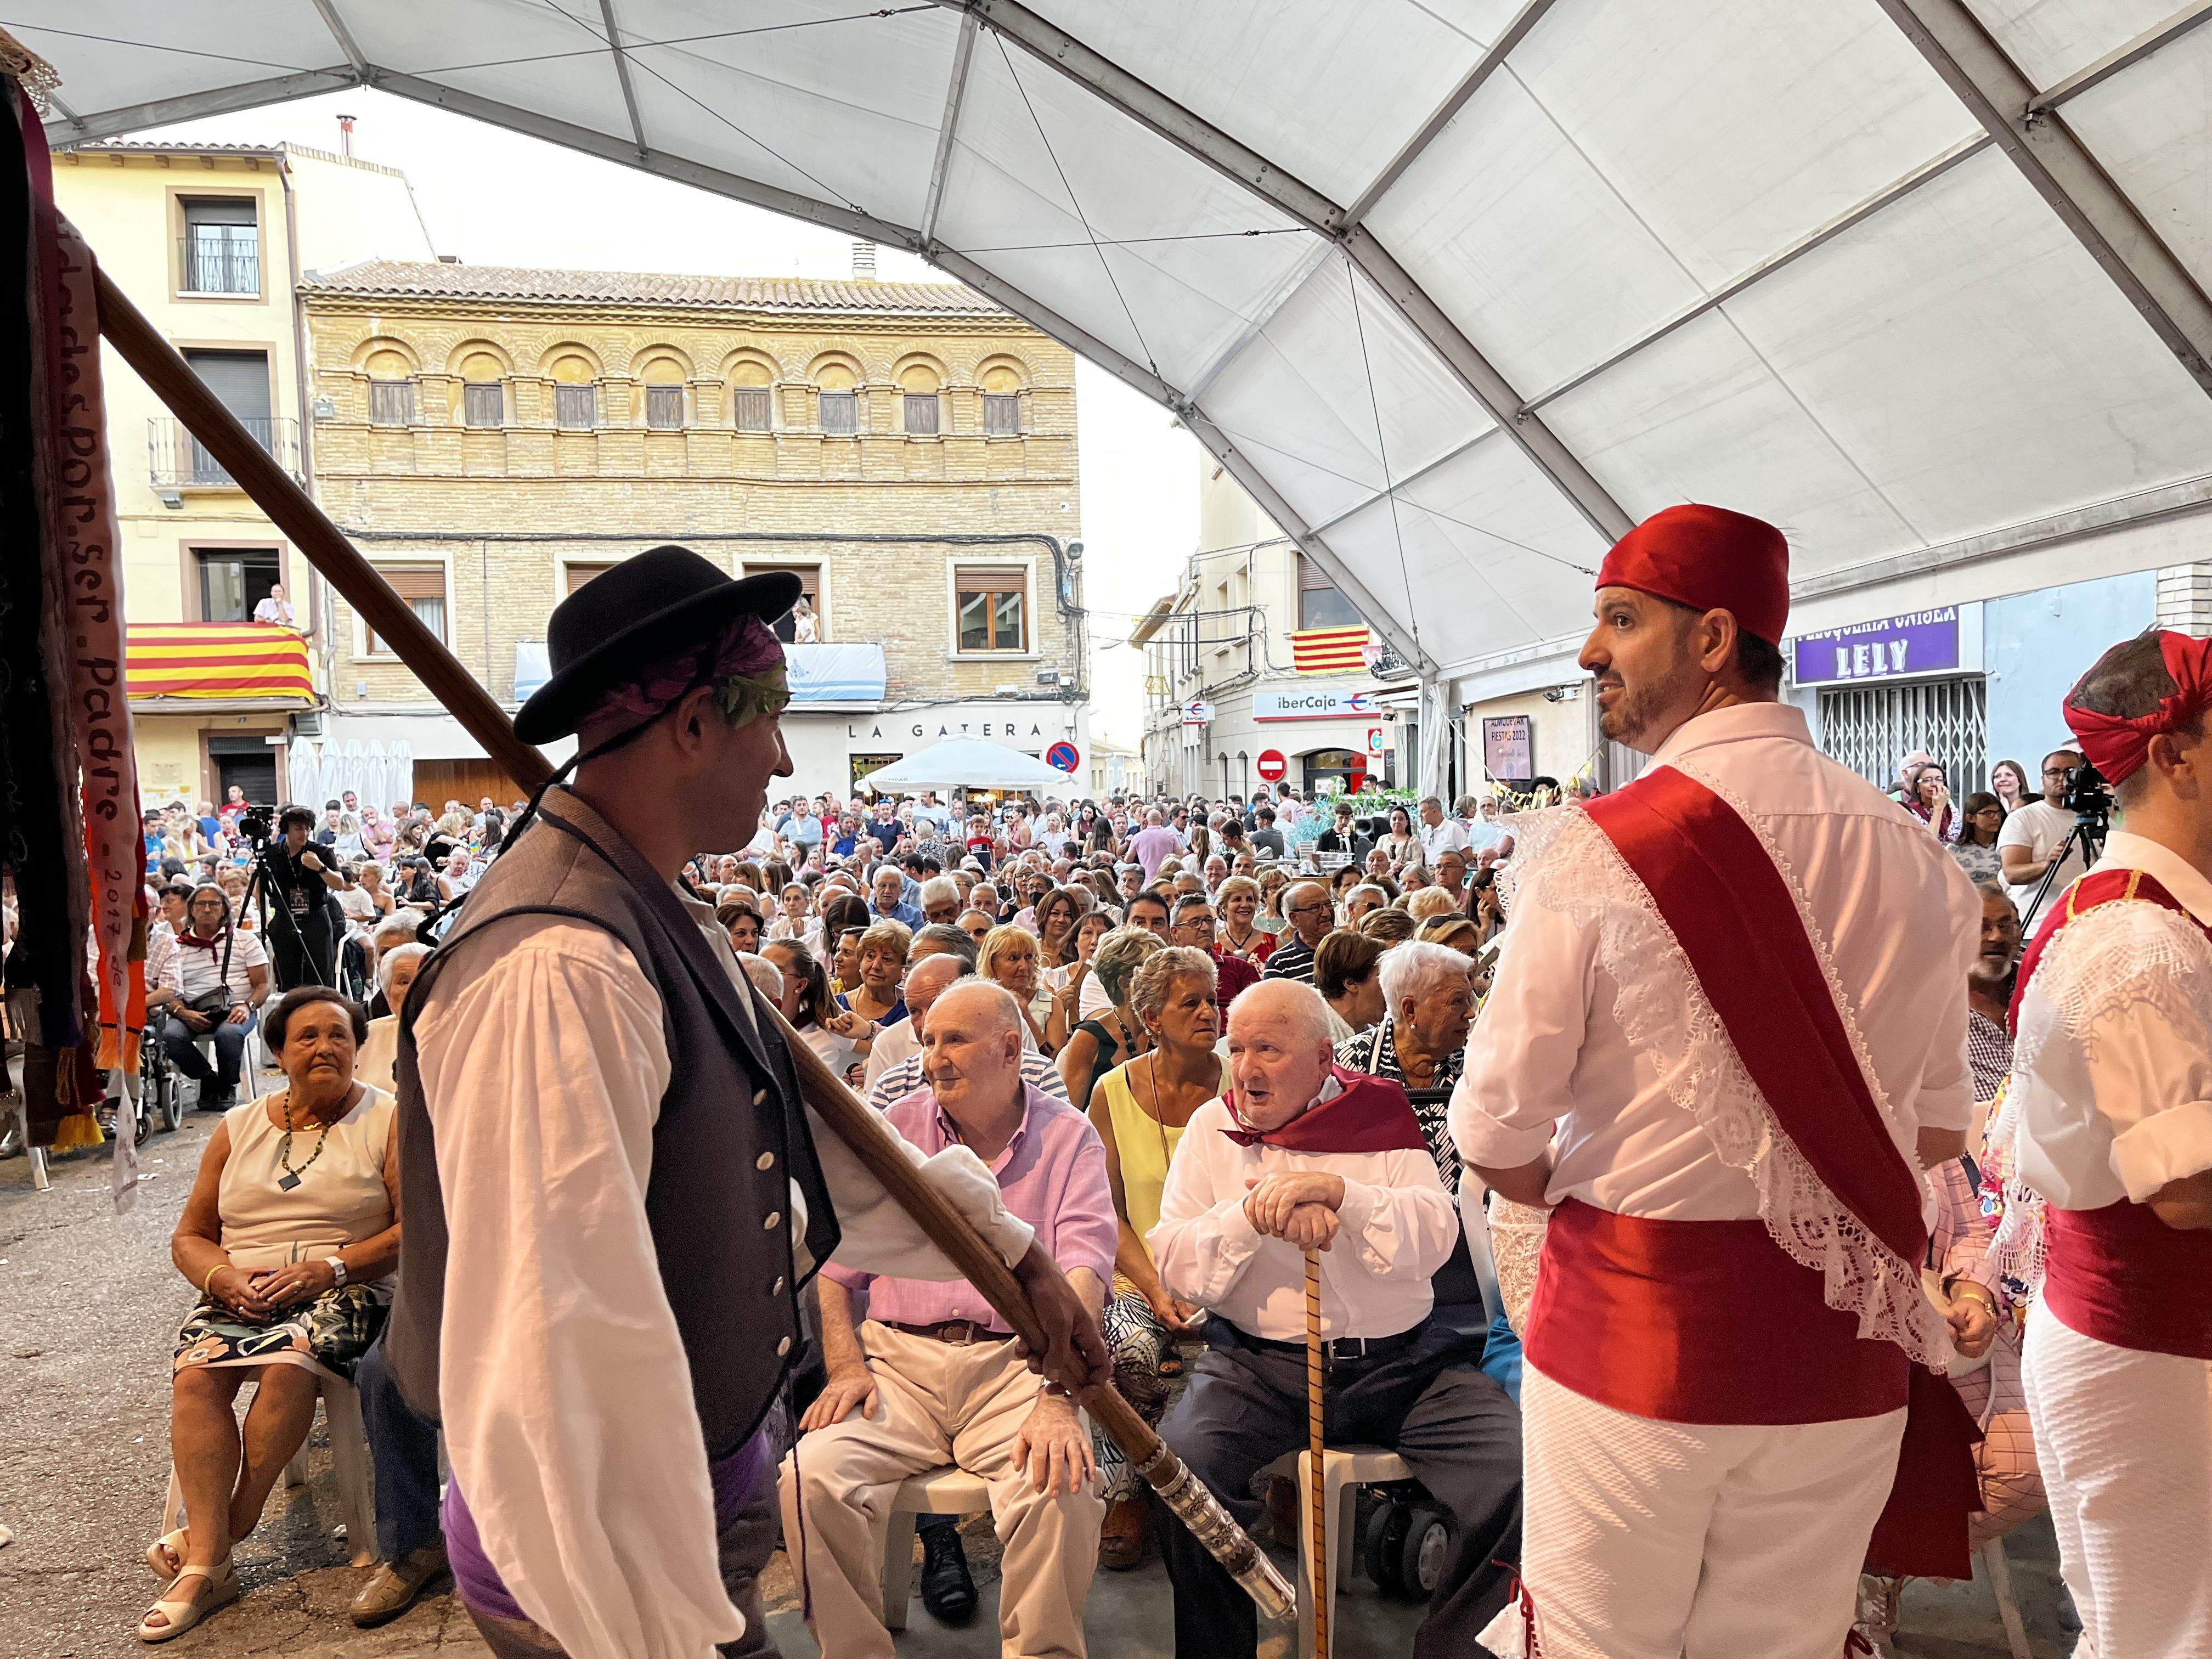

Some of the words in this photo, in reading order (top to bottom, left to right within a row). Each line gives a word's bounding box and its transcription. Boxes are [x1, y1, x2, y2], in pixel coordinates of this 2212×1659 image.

[1836, 639, 1908, 678] LELY
[1278, 695, 1336, 710] iberCaja
[848, 725, 882, 738] LA
[912, 723, 1041, 737] GATERA
[1491, 731, 1511, 741] FIESTAS
[1513, 730, 1526, 741] 2022
[79, 657, 122, 822] padre
[104, 870, 122, 938] 2017
